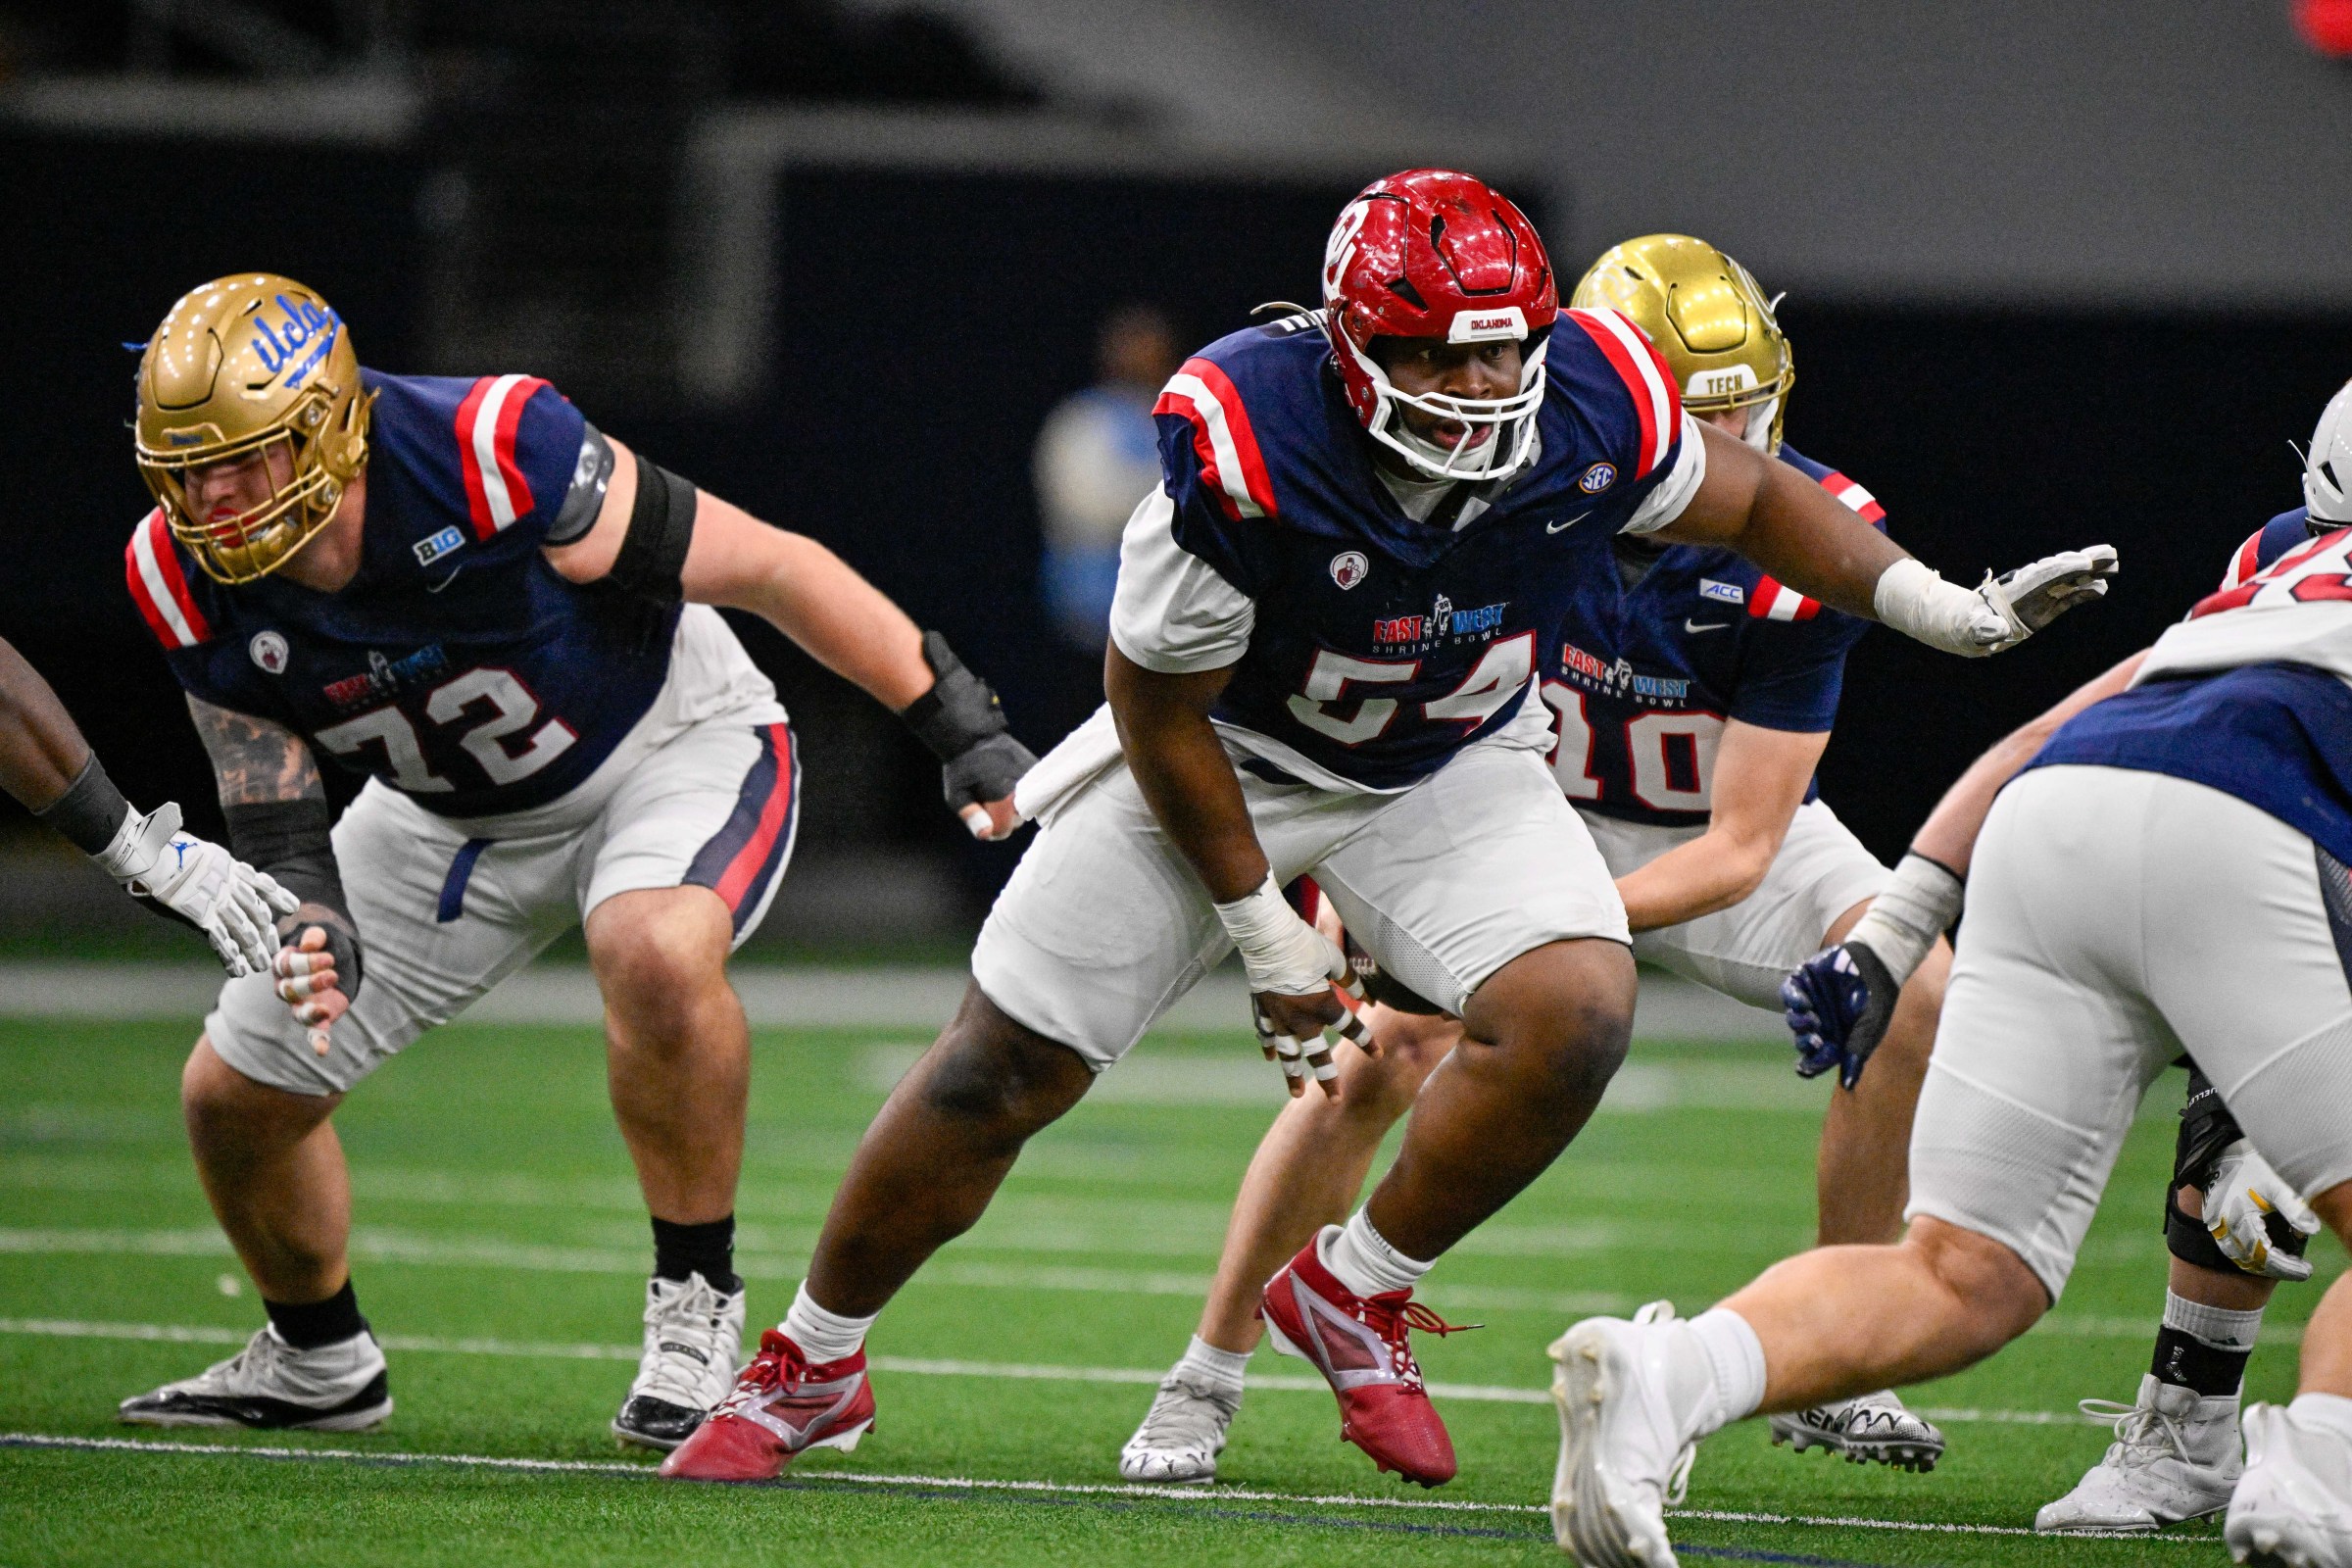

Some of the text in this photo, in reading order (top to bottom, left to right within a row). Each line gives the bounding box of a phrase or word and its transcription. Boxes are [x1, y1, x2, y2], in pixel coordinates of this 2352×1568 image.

[1471, 317, 1513, 330] OKLAHOMA
[1706, 373, 1743, 395] TECH
[1583, 466, 1612, 490] SEC
[1706, 584, 1741, 600] ACC
[1372, 627, 1501, 655] SHRINE BOWL
[1373, 603, 1507, 644] EAST WEST
[1285, 628, 1537, 751] 54
[1560, 665, 1686, 708] SHRINE BOWL
[1562, 643, 1690, 699] EAST WEST
[314, 666, 579, 793] 72
[1539, 677, 1727, 811] 10
